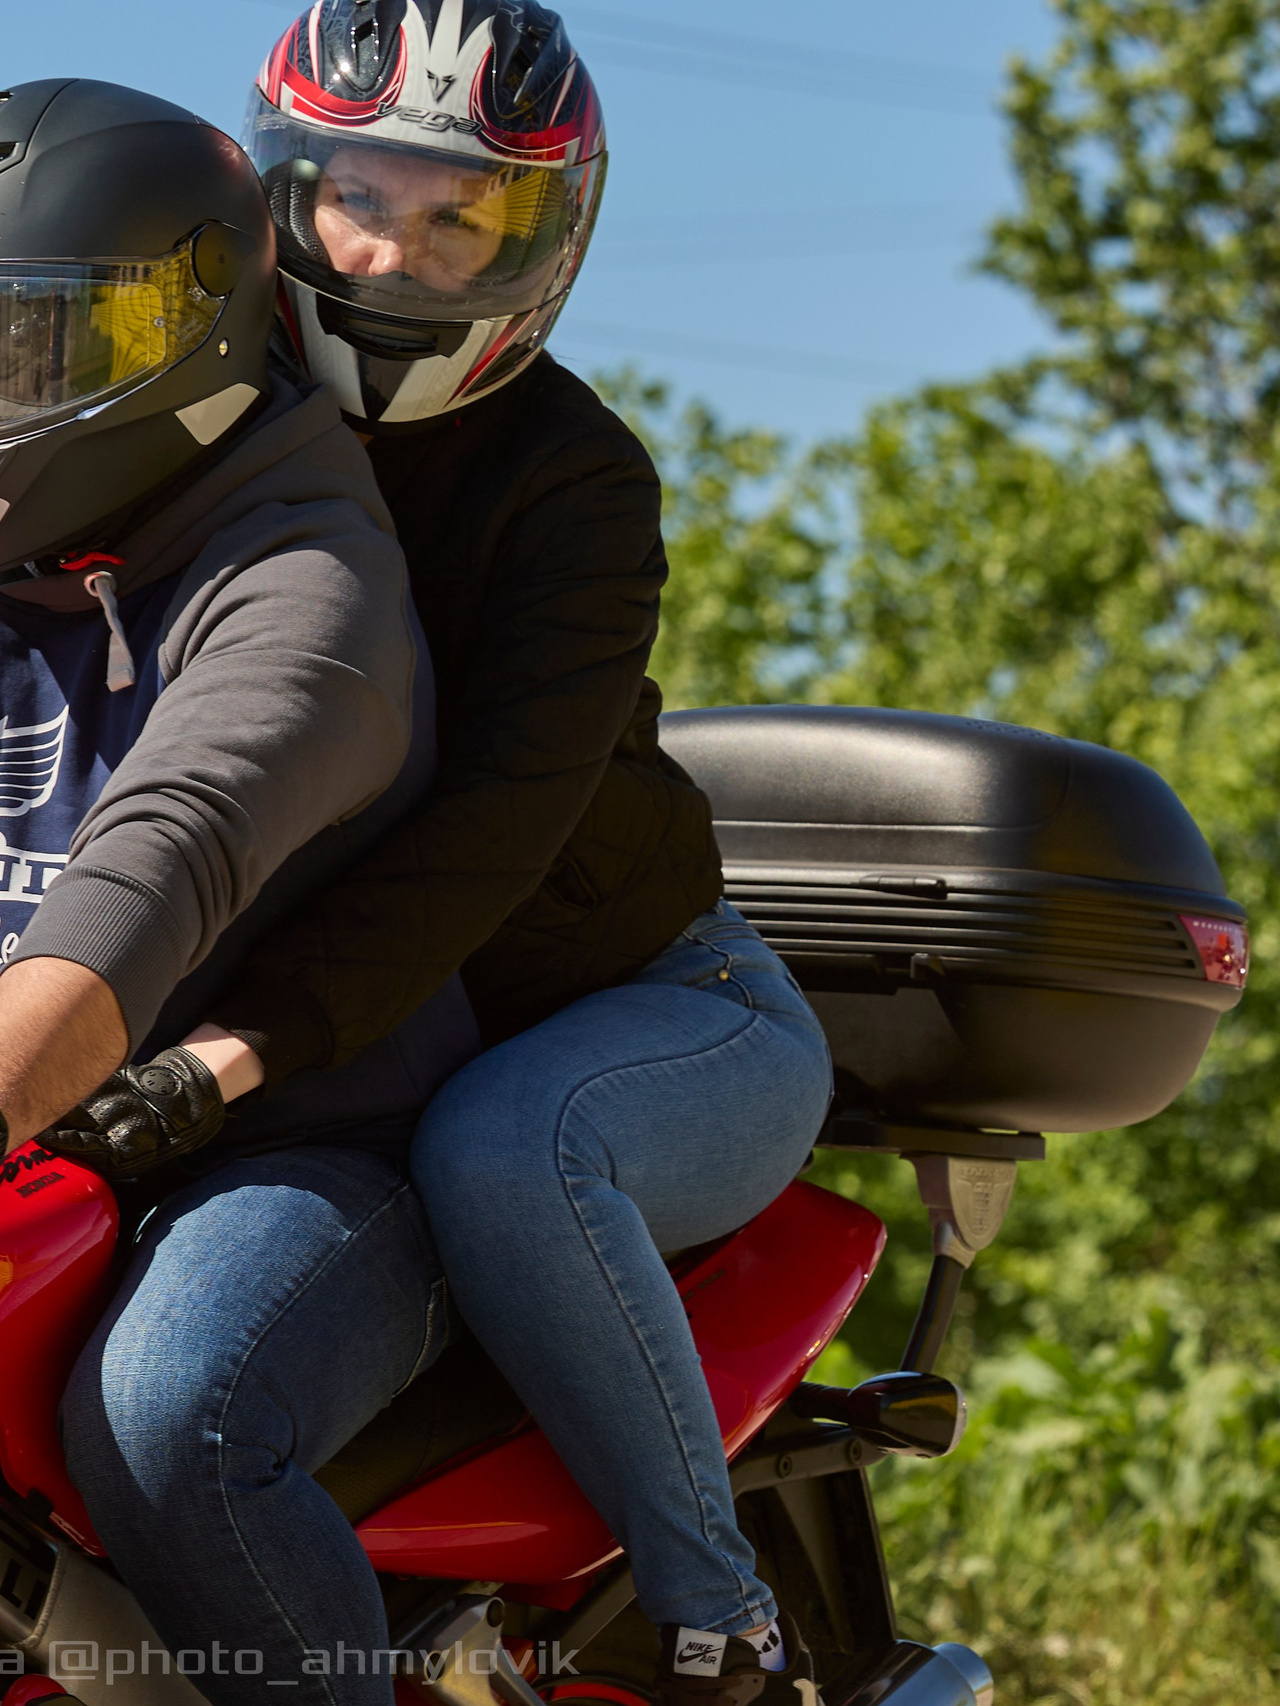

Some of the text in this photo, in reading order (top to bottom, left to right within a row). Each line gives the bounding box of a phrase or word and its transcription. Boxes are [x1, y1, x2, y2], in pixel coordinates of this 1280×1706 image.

[375, 102, 482, 135] vega
[16, 1172, 66, 1198] HONDA
[685, 1641, 714, 1652] NIKE
[698, 1654, 718, 1665] AIR
